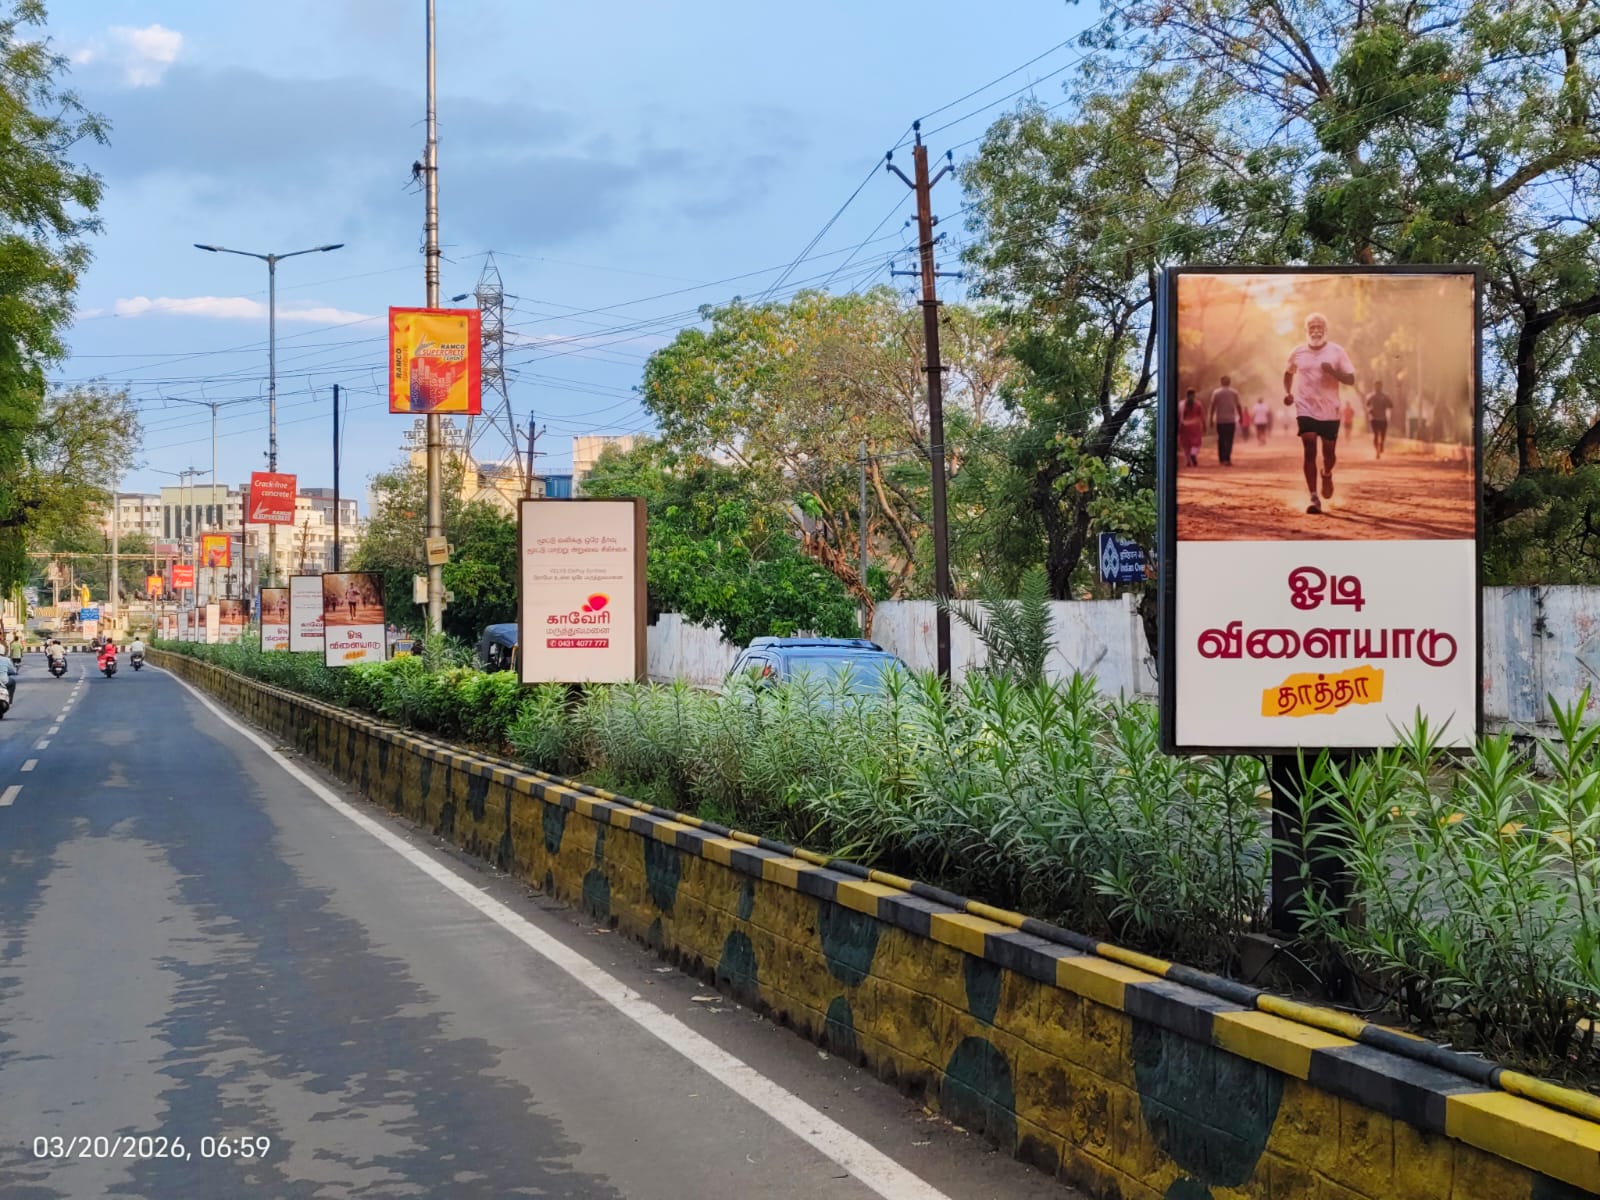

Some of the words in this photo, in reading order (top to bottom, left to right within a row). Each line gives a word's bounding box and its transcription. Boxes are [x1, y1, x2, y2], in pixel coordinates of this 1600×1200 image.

[254, 480, 288, 489] Crack-free
[1288, 566, 1366, 612] ஓடி
[546, 610, 611, 625] காவேரி
[545, 627, 610, 637] மருத்துவமனை
[1197, 620, 1458, 667] விளையாடு
[1277, 673, 1369, 715] தாத்தா
